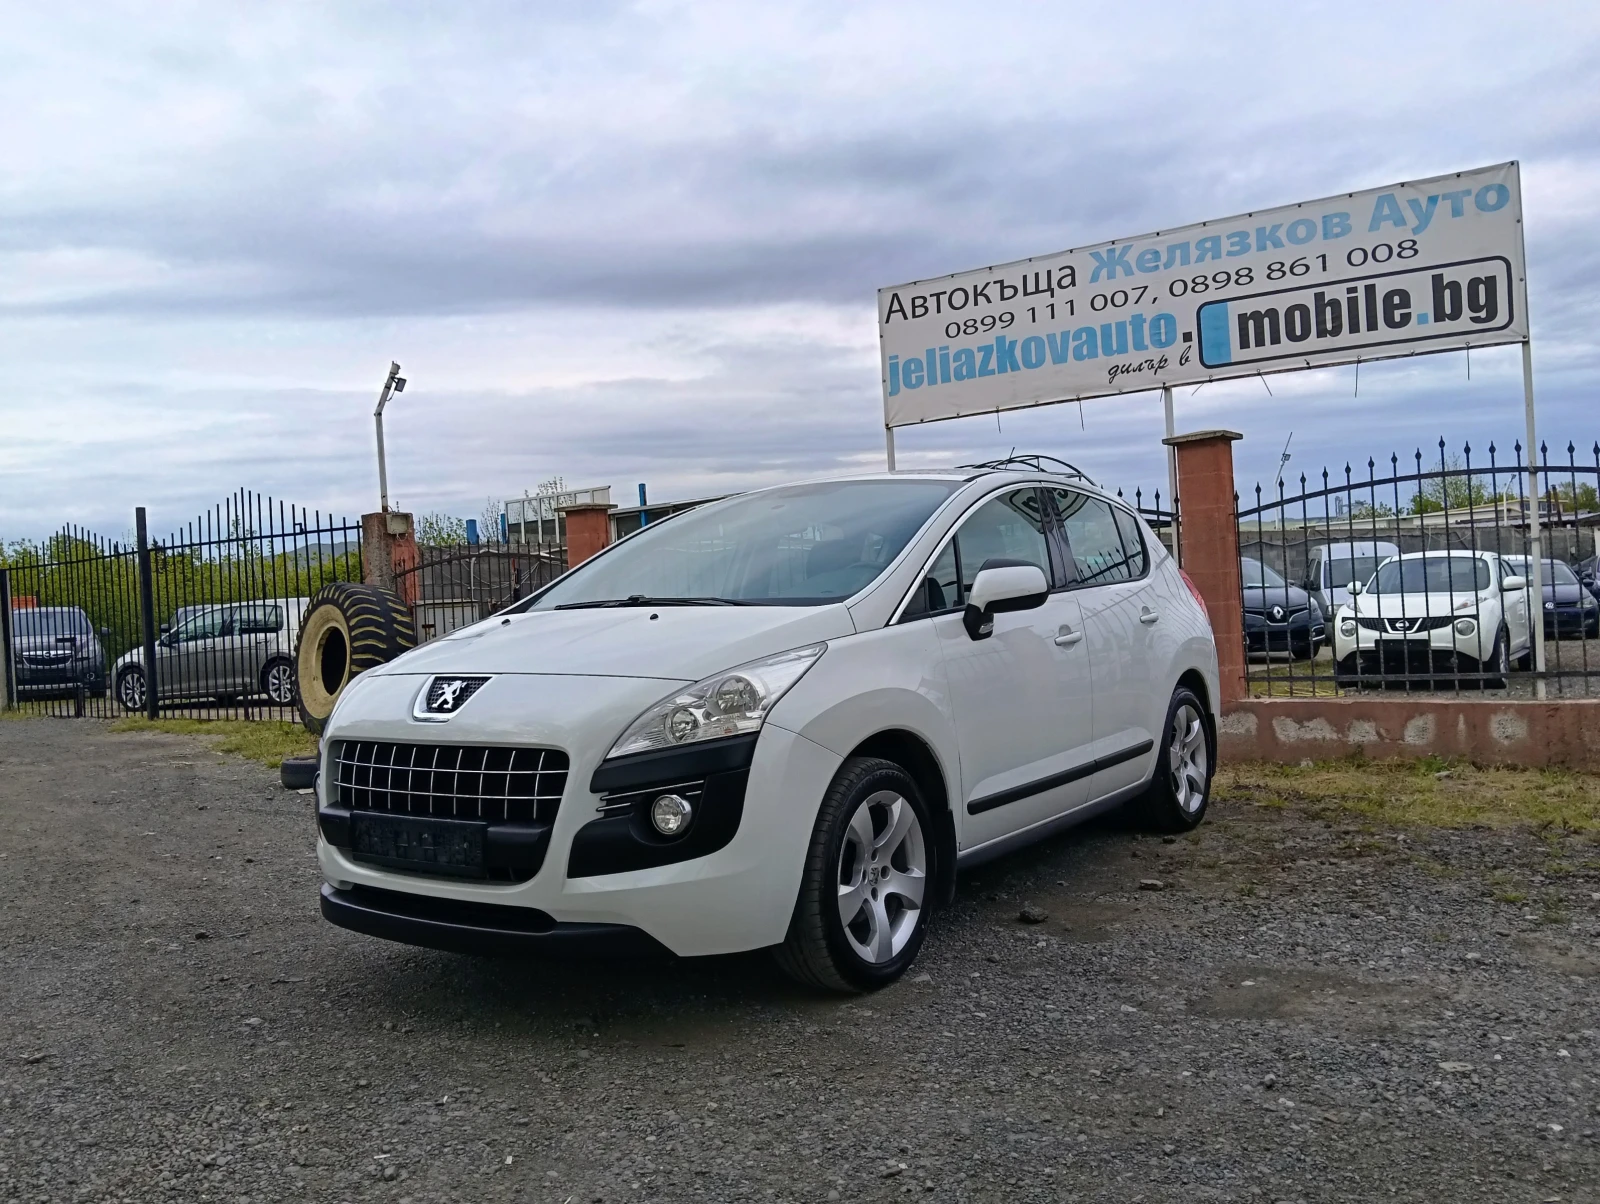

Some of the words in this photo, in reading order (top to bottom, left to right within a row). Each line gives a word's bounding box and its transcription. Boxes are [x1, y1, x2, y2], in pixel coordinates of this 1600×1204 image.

[885, 264, 1077, 324] Автокъща
[1089, 211, 1353, 284] Желязков
[1368, 183, 1511, 236] Ауто
[945, 311, 1015, 338] 0899
[1026, 299, 1075, 323] 111
[1090, 285, 1158, 311] 007,
[1168, 267, 1255, 297] 0898
[1266, 253, 1328, 280] 861
[1346, 239, 1419, 267] 008
[1237, 273, 1499, 350] mobile.bg
[1108, 354, 1169, 383] дилър
[1179, 345, 1192, 366] в
